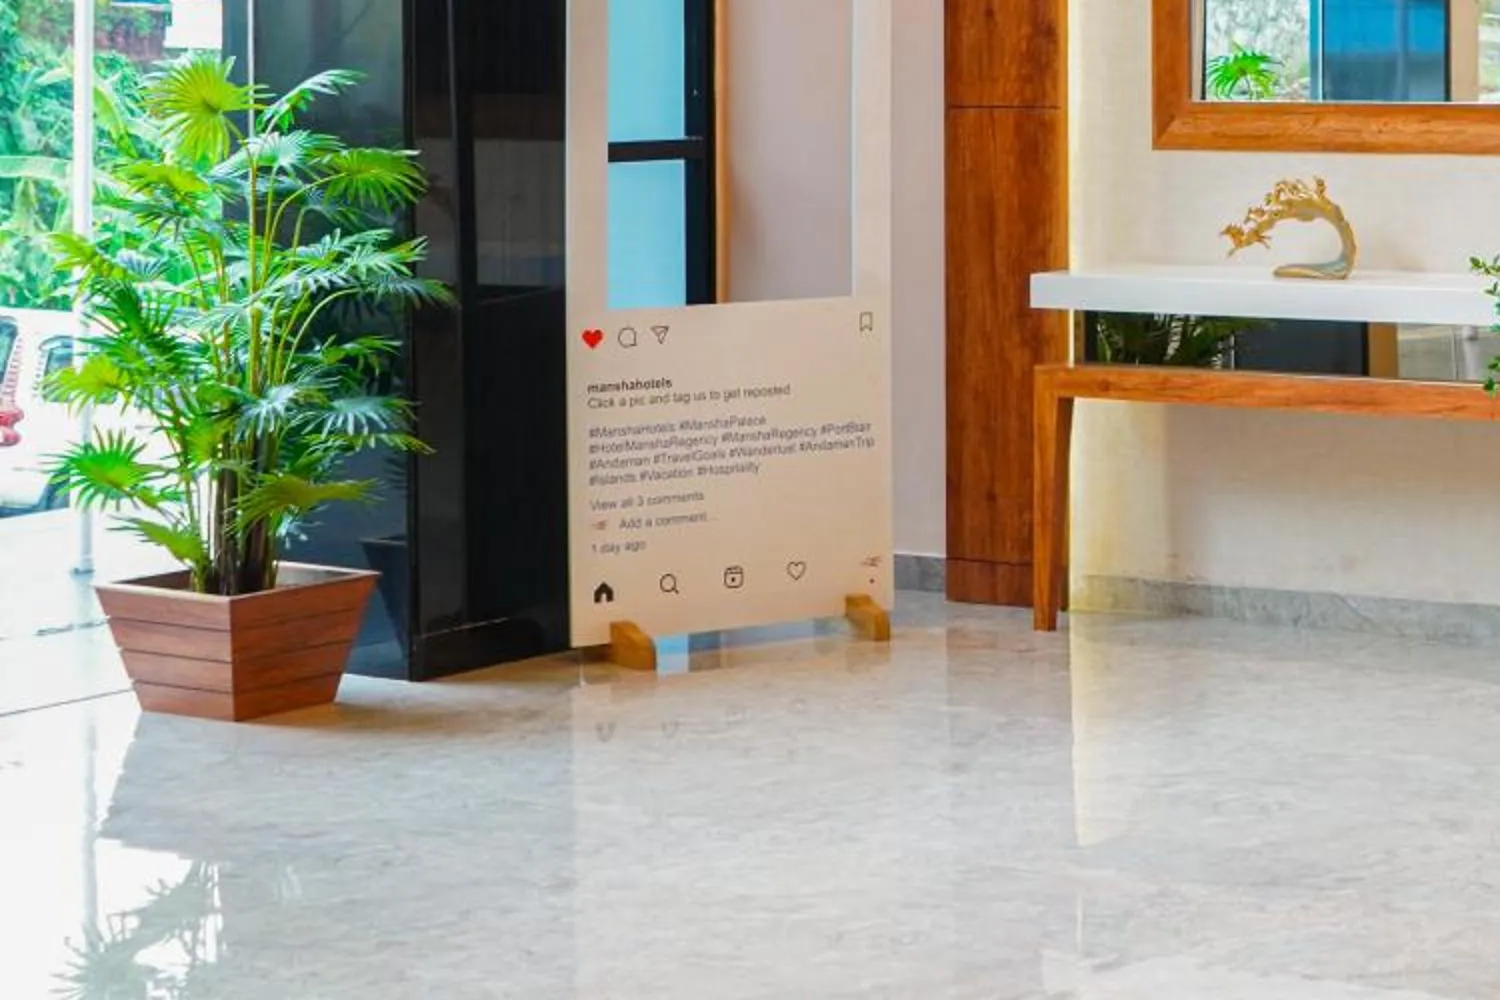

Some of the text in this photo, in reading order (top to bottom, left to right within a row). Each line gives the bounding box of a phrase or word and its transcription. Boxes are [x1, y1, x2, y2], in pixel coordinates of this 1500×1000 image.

[587, 377, 673, 394] manshahotels
[649, 392, 670, 405] and
[673, 391, 691, 405] tag
[694, 391, 706, 401] us
[709, 389, 721, 400] to
[723, 387, 741, 402] get
[743, 383, 791, 399] reposted
[590, 499, 617, 511] View
[620, 497, 633, 508] all
[646, 491, 705, 506] comments
[619, 518, 642, 529] Add
[600, 542, 621, 555] day
[624, 540, 647, 552] ago
